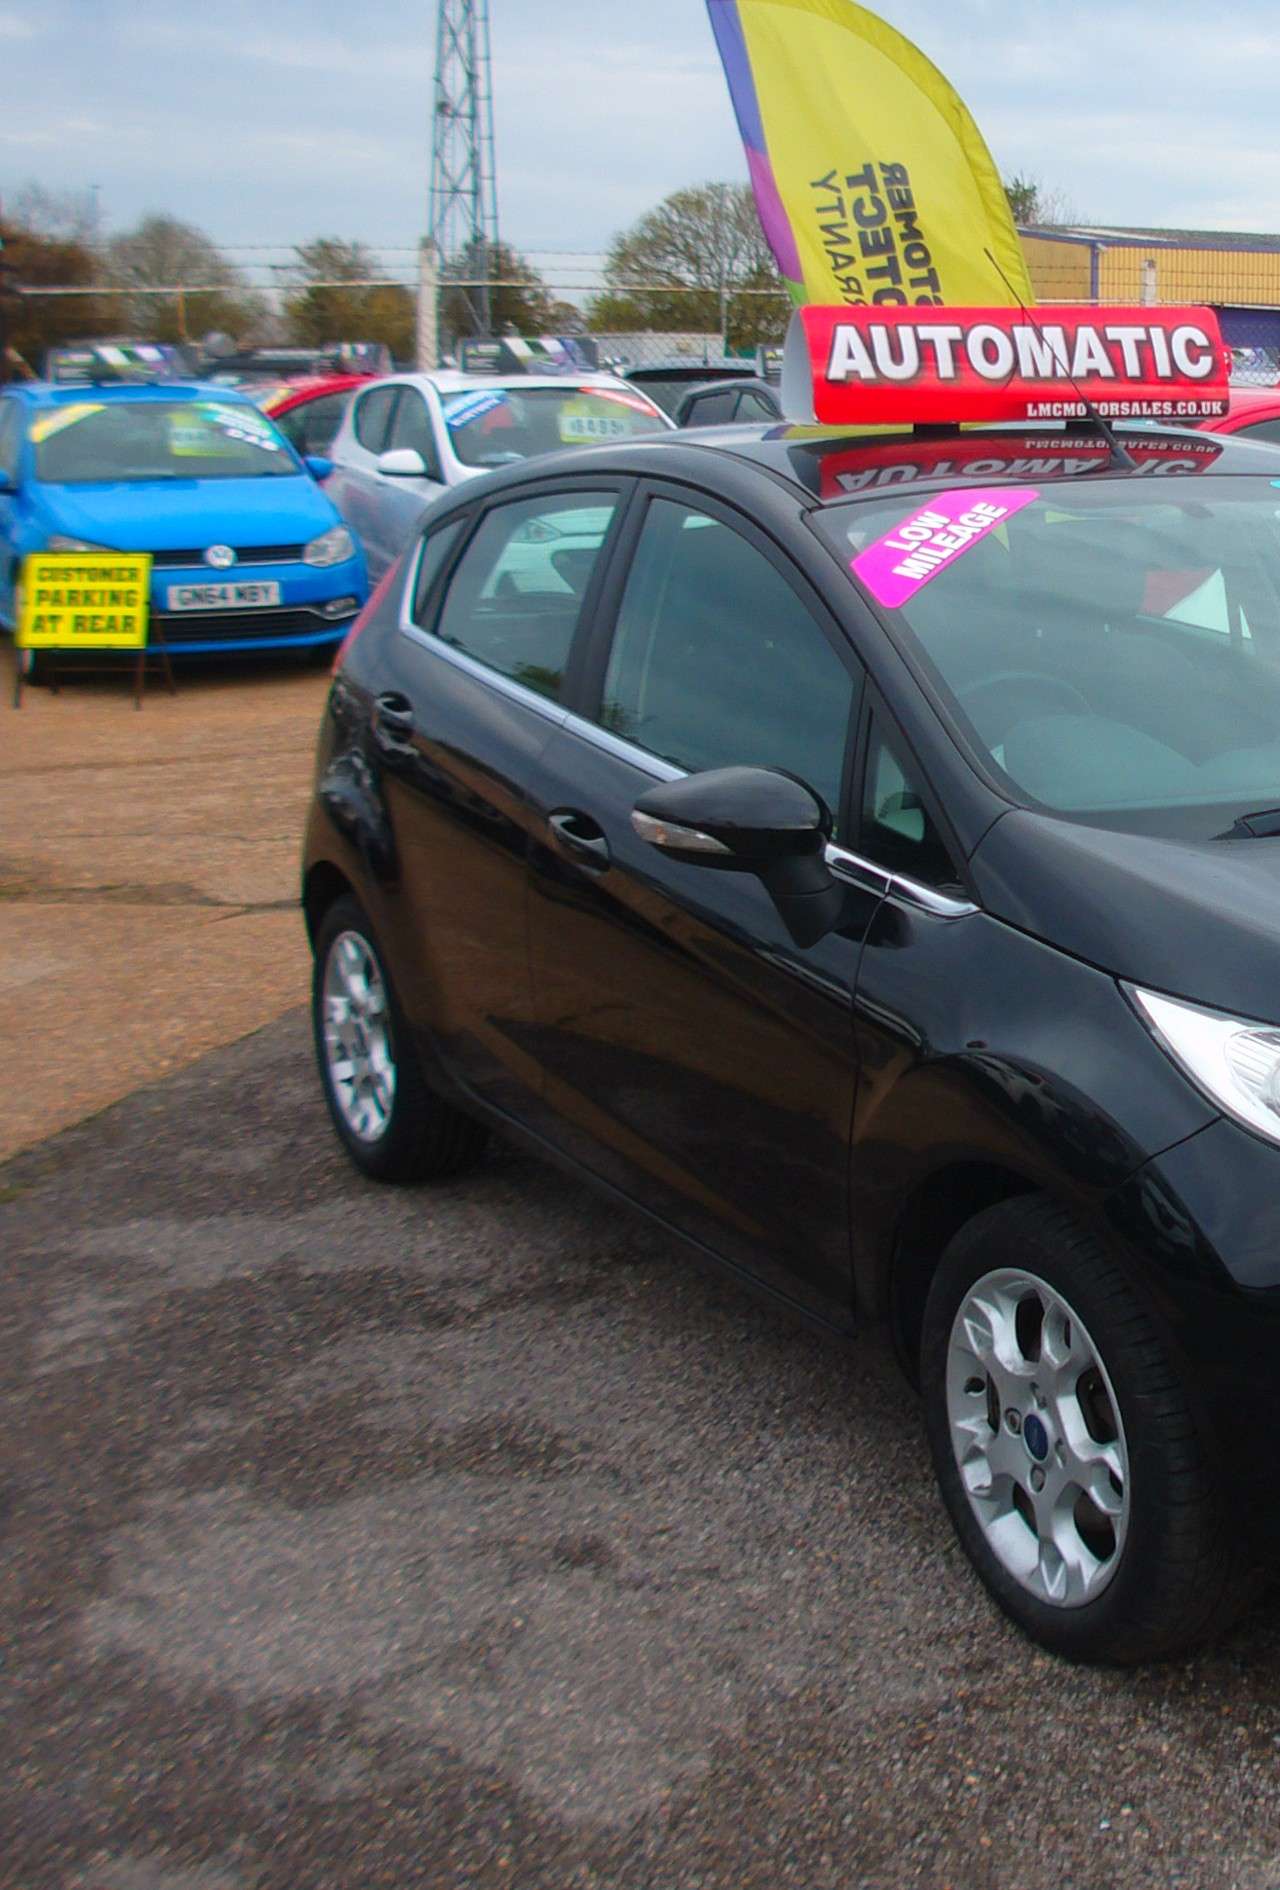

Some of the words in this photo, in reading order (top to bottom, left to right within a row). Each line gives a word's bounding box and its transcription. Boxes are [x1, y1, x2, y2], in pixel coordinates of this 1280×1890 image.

[826, 324, 1213, 379] AUTOMATIC
[883, 510, 950, 551] LOW
[891, 502, 1008, 580] MILEAGE
[37, 567, 141, 583] CUSTOMER
[36, 589, 139, 607] PARKING
[32, 615, 64, 634] AT
[72, 615, 136, 633] REAR
